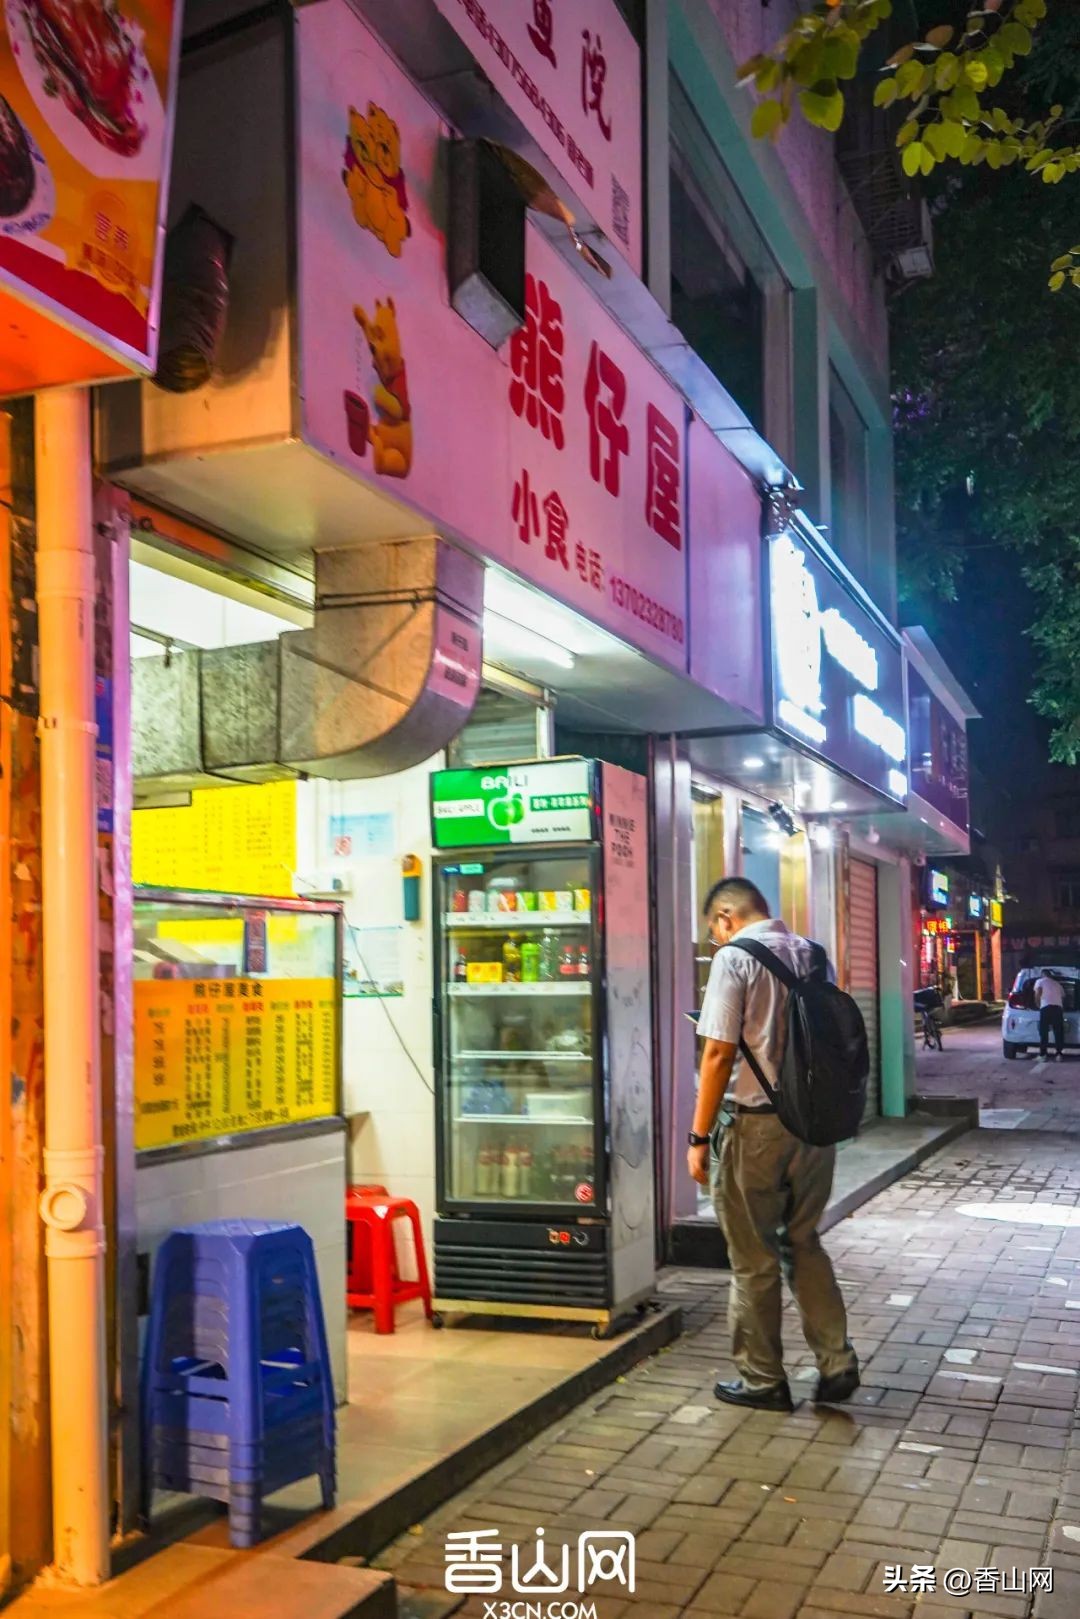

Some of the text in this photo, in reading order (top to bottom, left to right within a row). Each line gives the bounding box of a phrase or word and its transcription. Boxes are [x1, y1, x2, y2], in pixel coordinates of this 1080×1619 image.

[509, 272, 681, 551] 熊仔屋
[511, 468, 570, 571] 小食
